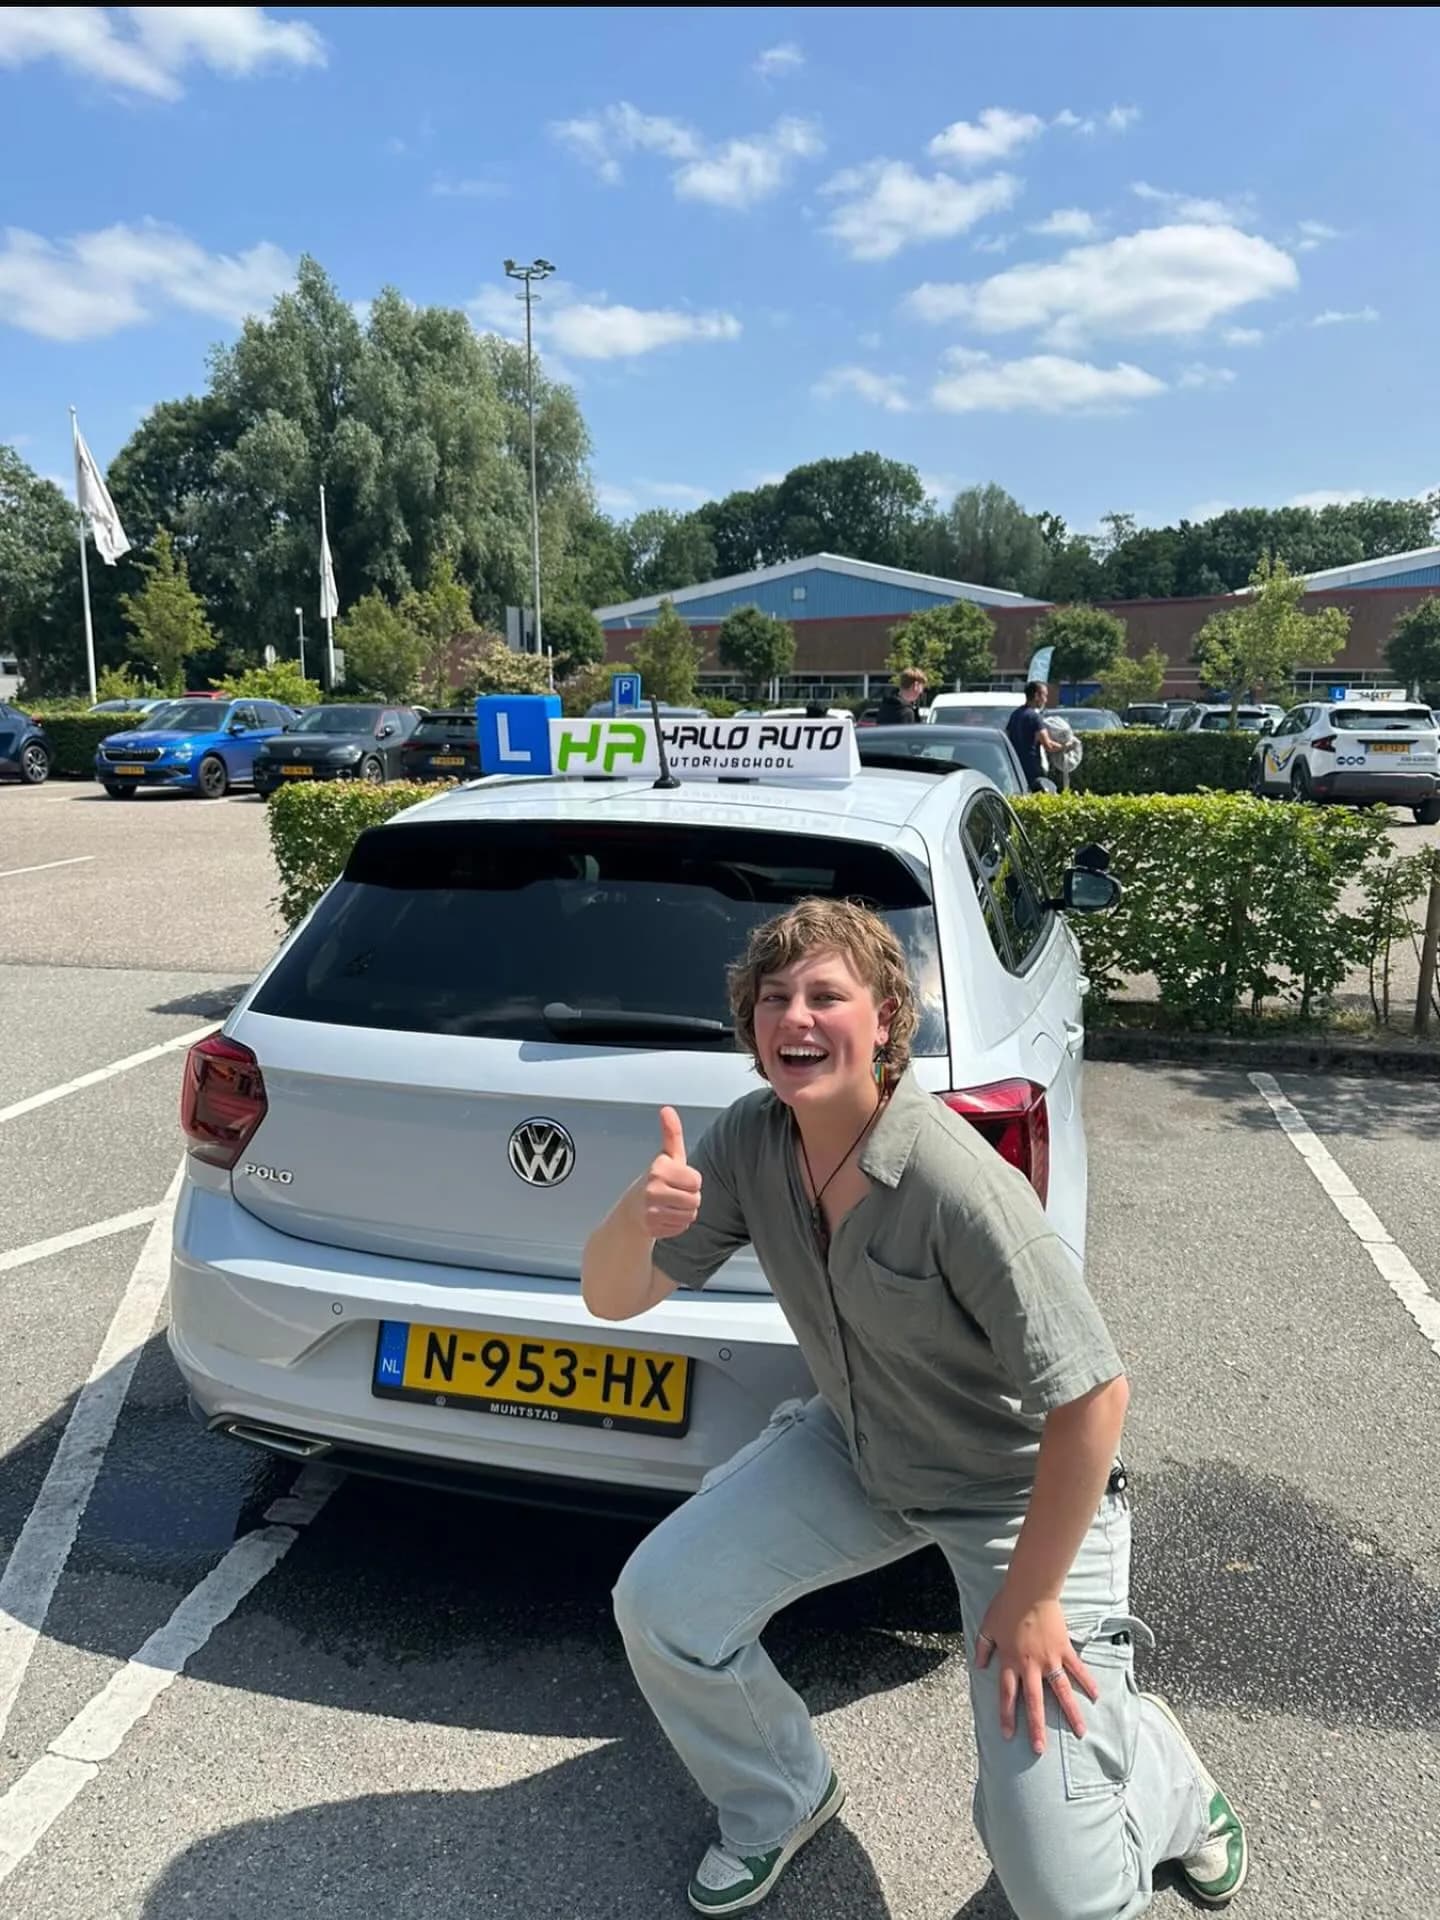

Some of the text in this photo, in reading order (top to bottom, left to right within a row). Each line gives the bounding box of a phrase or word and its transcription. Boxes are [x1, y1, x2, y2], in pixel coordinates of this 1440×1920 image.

[621, 681, 631, 695] P
[1335, 690, 1343, 699] L
[496, 712, 532, 763] L
[557, 722, 648, 772] HA
[758, 726, 844, 750] AUTO
[669, 755, 794, 769] UTORIJSCHOOL
[244, 1163, 294, 1184] POLO
[382, 1357, 400, 1374] NL
[423, 1331, 675, 1411] N-953-HX
[489, 1402, 560, 1422] MUNTSTAD
